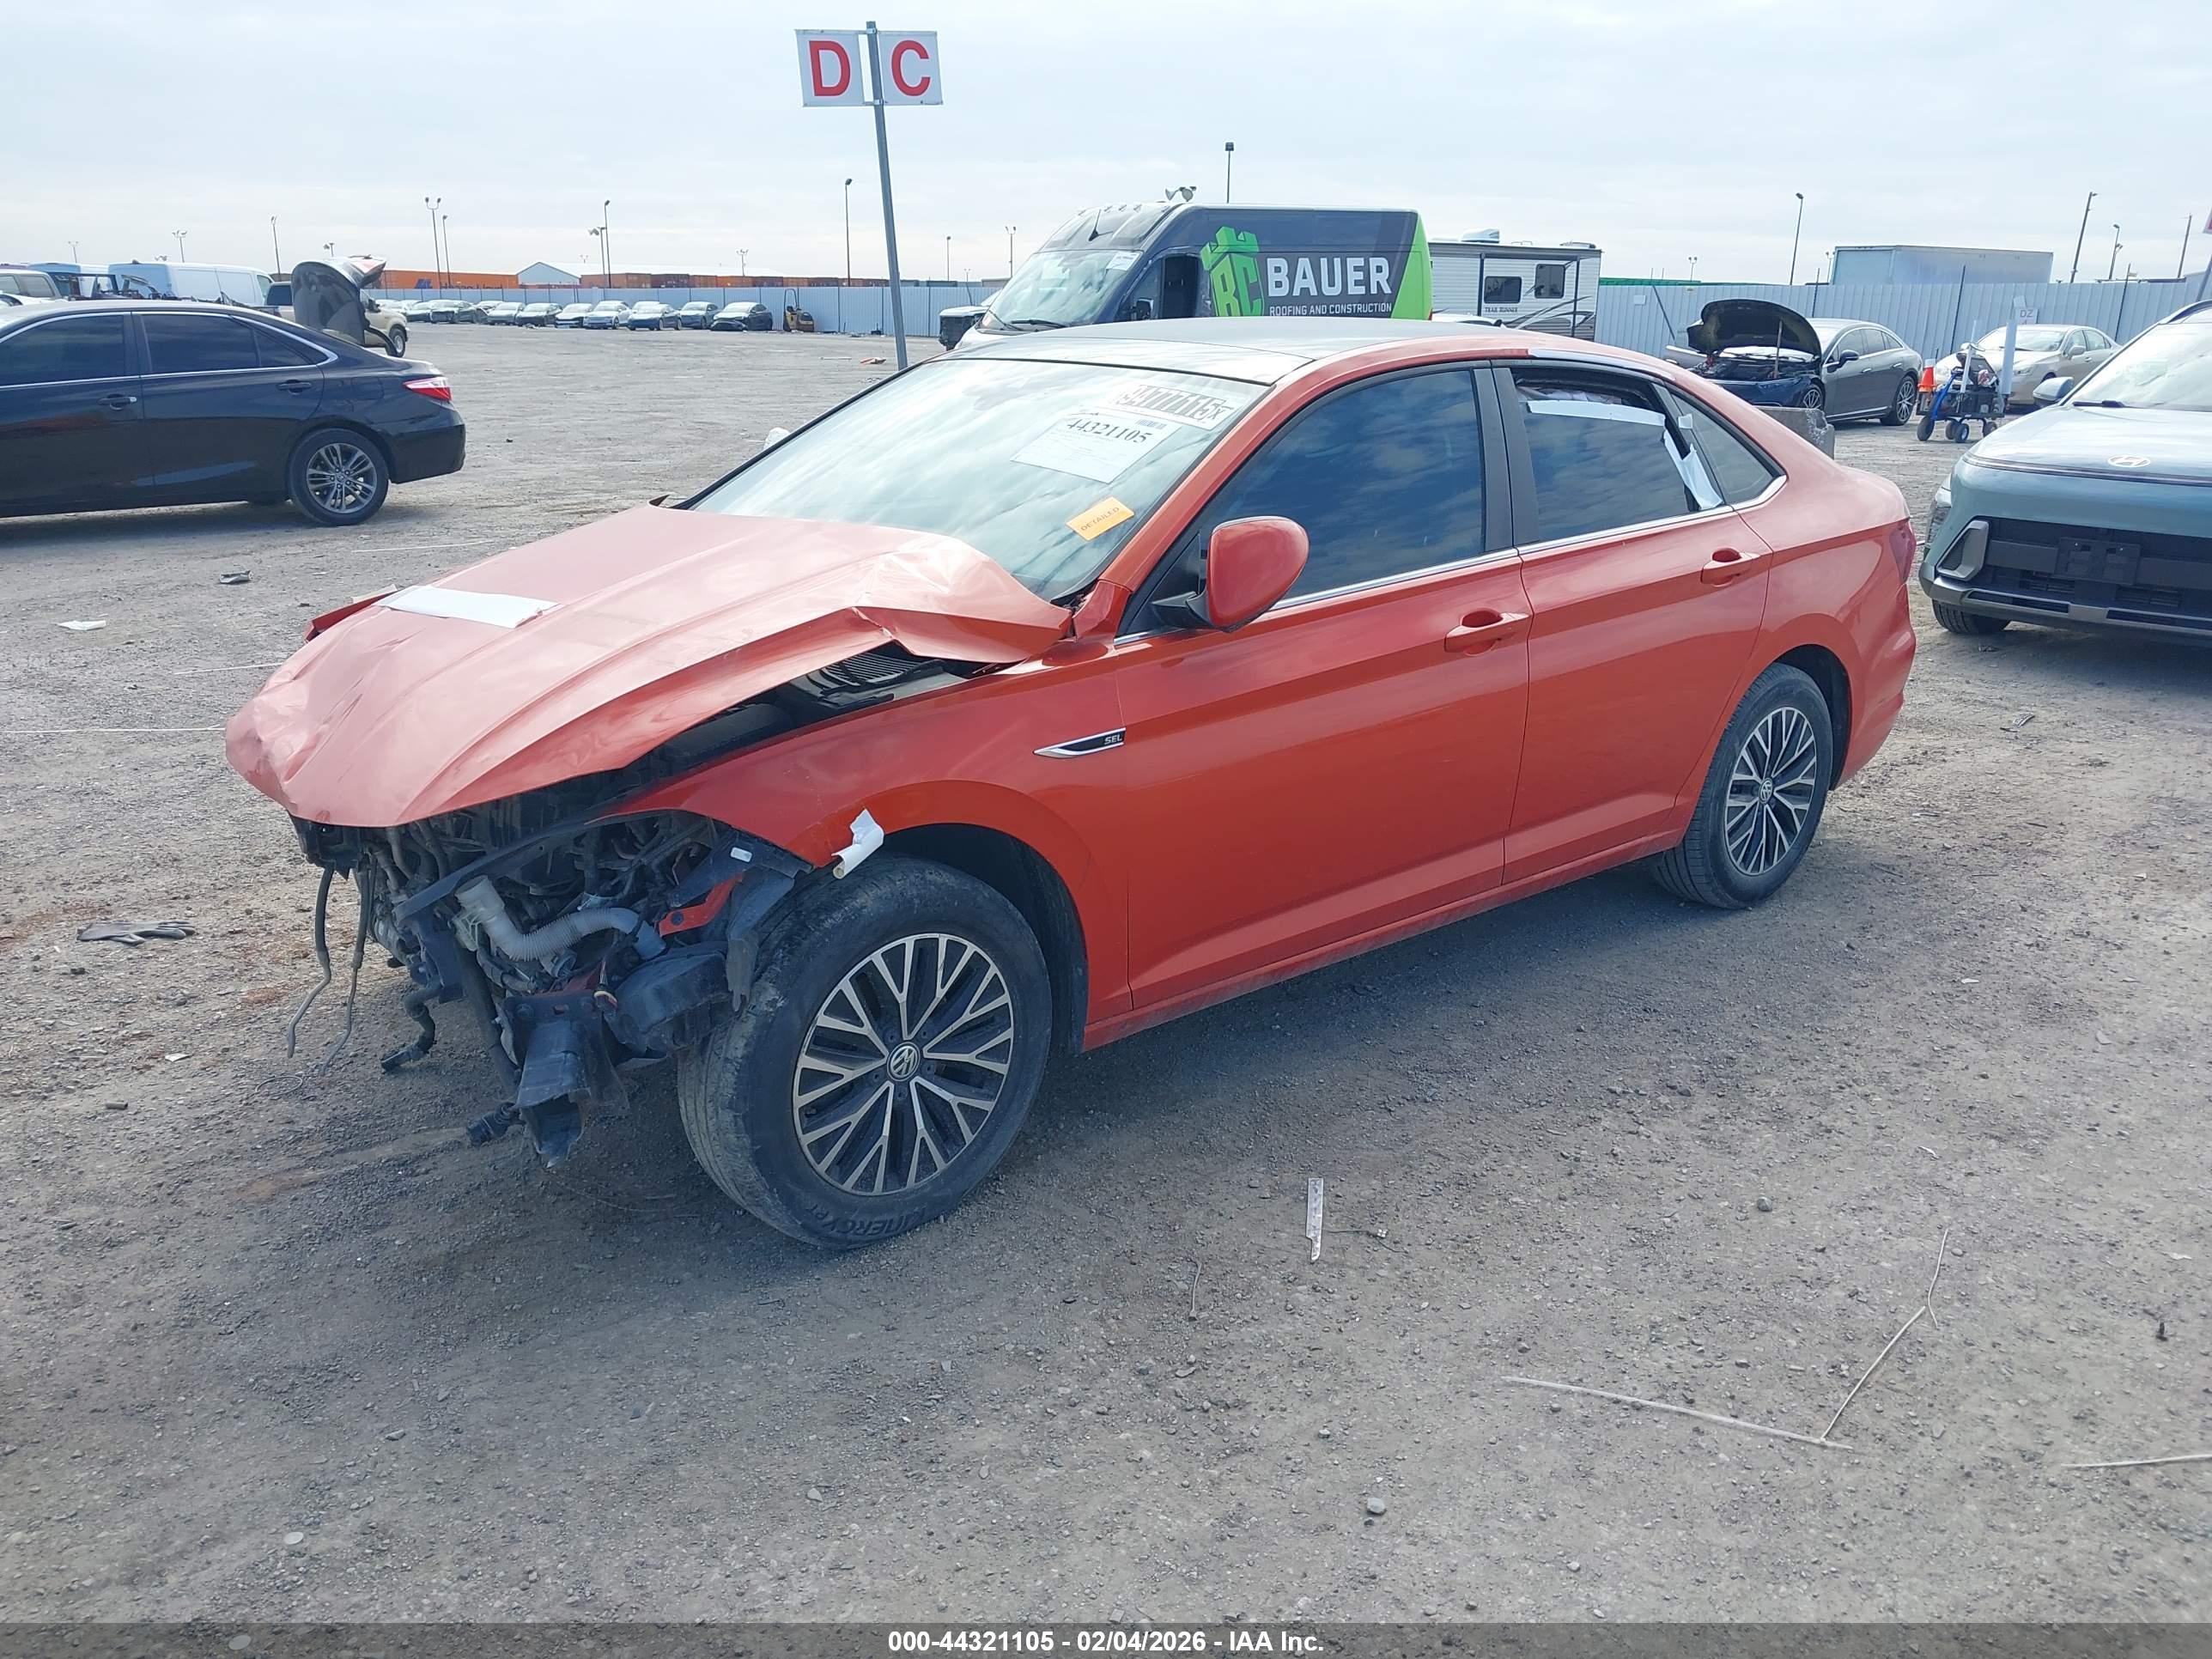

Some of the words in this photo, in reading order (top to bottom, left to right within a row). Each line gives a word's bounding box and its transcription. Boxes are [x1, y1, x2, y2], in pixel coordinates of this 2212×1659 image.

[808, 40, 851, 96] D
[891, 40, 931, 96] C
[1267, 257, 1392, 297] BAUER
[1269, 305, 1307, 317] ROOFING
[1310, 304, 1328, 315] AND
[1328, 302, 1392, 314] CONSTRUCTION
[1066, 417, 1154, 443] 44321105
[1080, 507, 1120, 531] DETAILED
[1104, 734, 1122, 745] SEL
